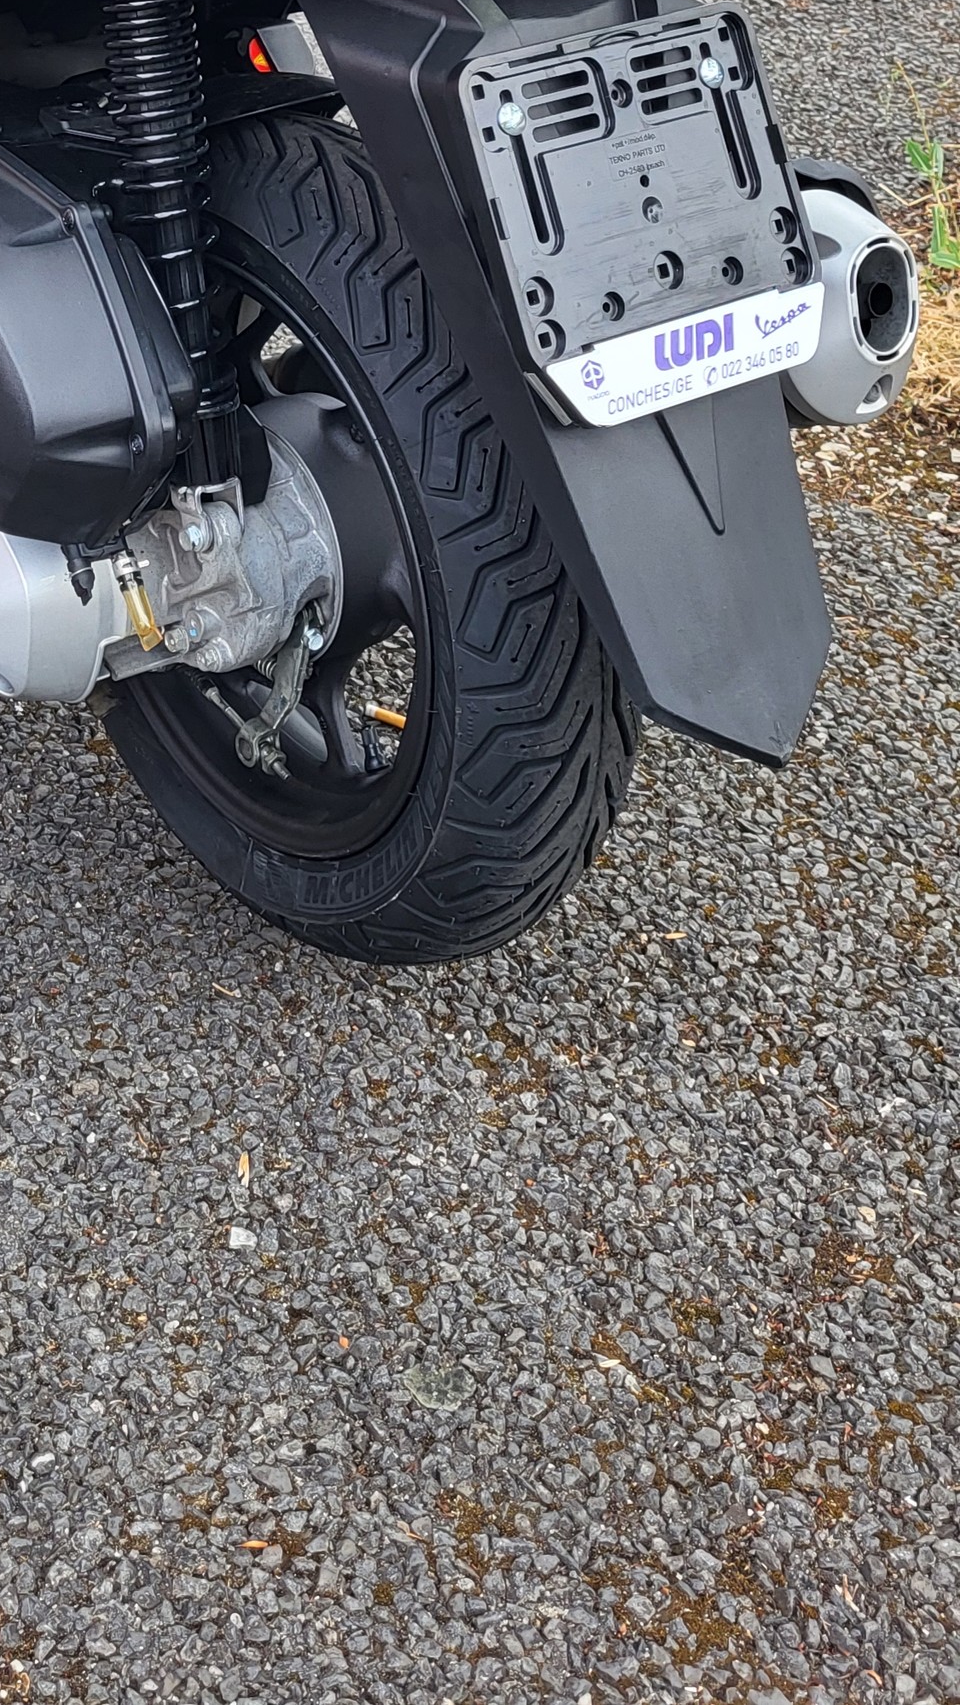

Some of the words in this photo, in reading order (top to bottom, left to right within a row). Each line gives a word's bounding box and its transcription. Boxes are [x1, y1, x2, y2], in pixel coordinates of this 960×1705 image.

[632, 146, 654, 160] PARTS
[654, 143, 666, 154] LTD
[654, 312, 735, 372] LUDI
[754, 302, 812, 339] Vespa
[607, 374, 694, 416] CONCHES/GE
[721, 359, 743, 379] 022
[745, 351, 767, 372] 346
[769, 345, 783, 364] 05
[785, 341, 800, 359] 80
